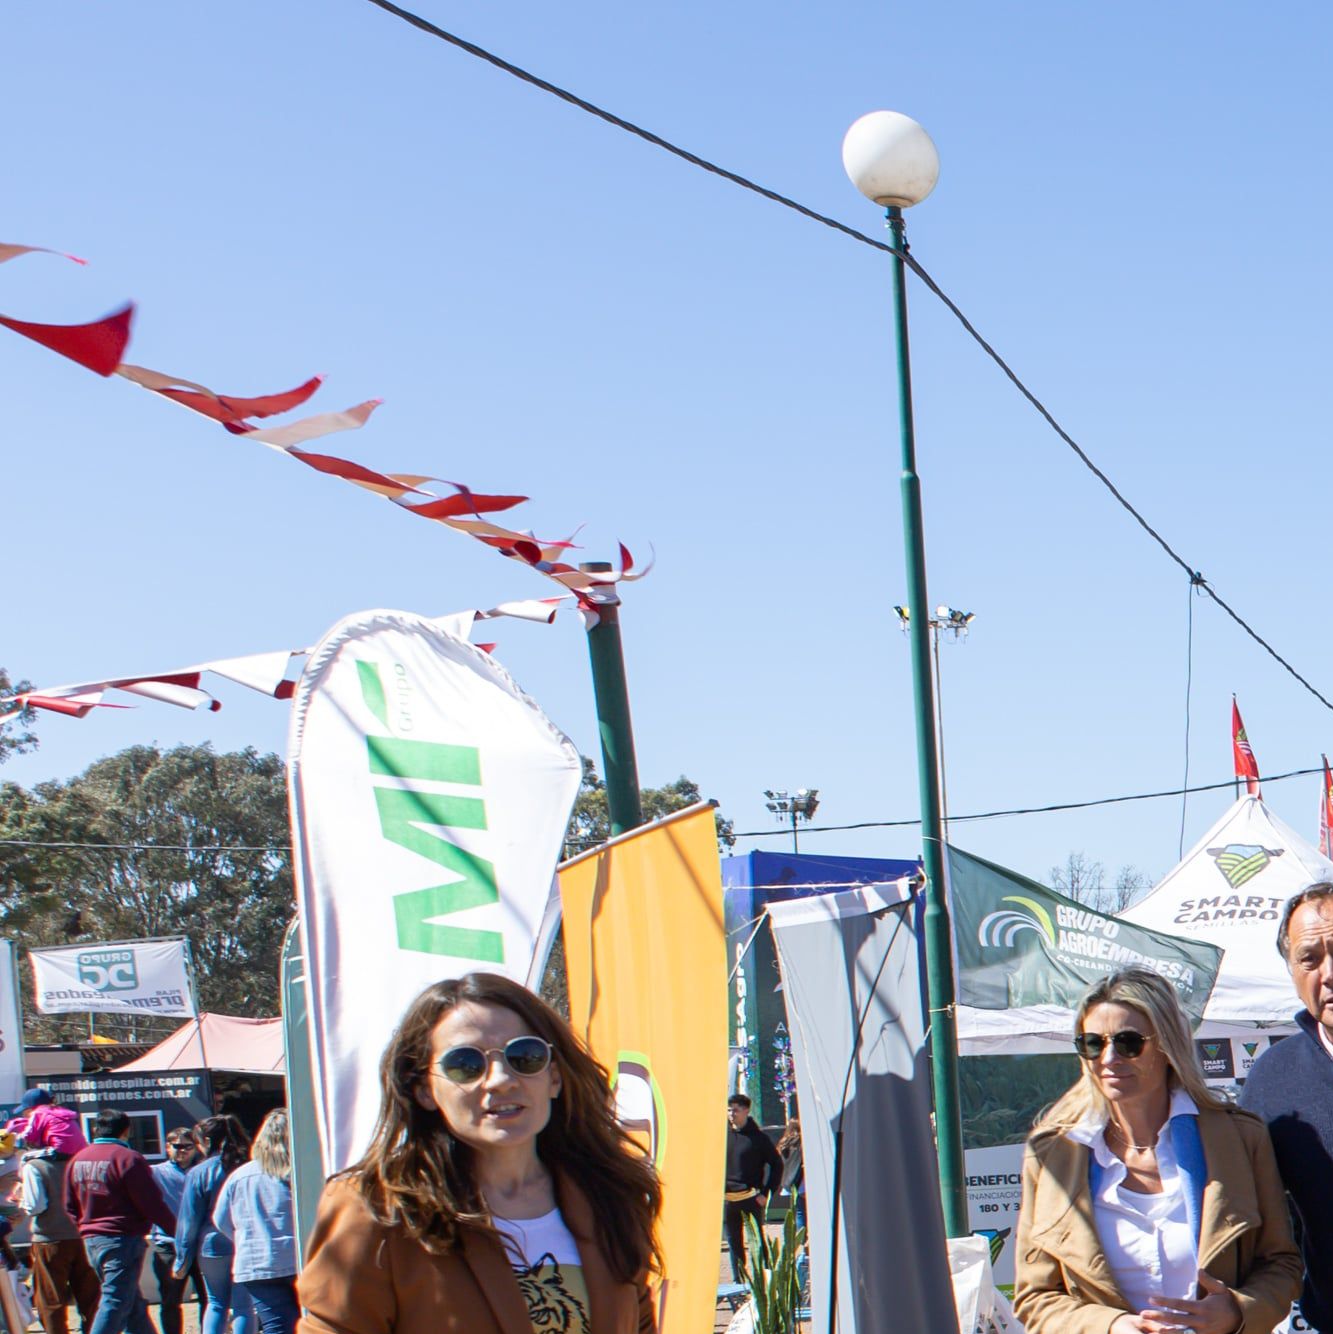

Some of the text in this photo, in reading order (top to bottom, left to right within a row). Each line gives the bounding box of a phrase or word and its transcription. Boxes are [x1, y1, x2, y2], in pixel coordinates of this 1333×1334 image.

[1179, 895, 1285, 912] SMART
[1056, 903, 1119, 939] GRUPO
[1173, 909, 1279, 924] CAMPO
[1056, 954, 1115, 972] CO-CREAND
[1058, 933, 1195, 986] AGROEMPRESA
[55, 1088, 192, 1104] ilarportones.com.ar
[979, 1203, 999, 1213] 180
[1002, 1202, 1010, 1212] Y
